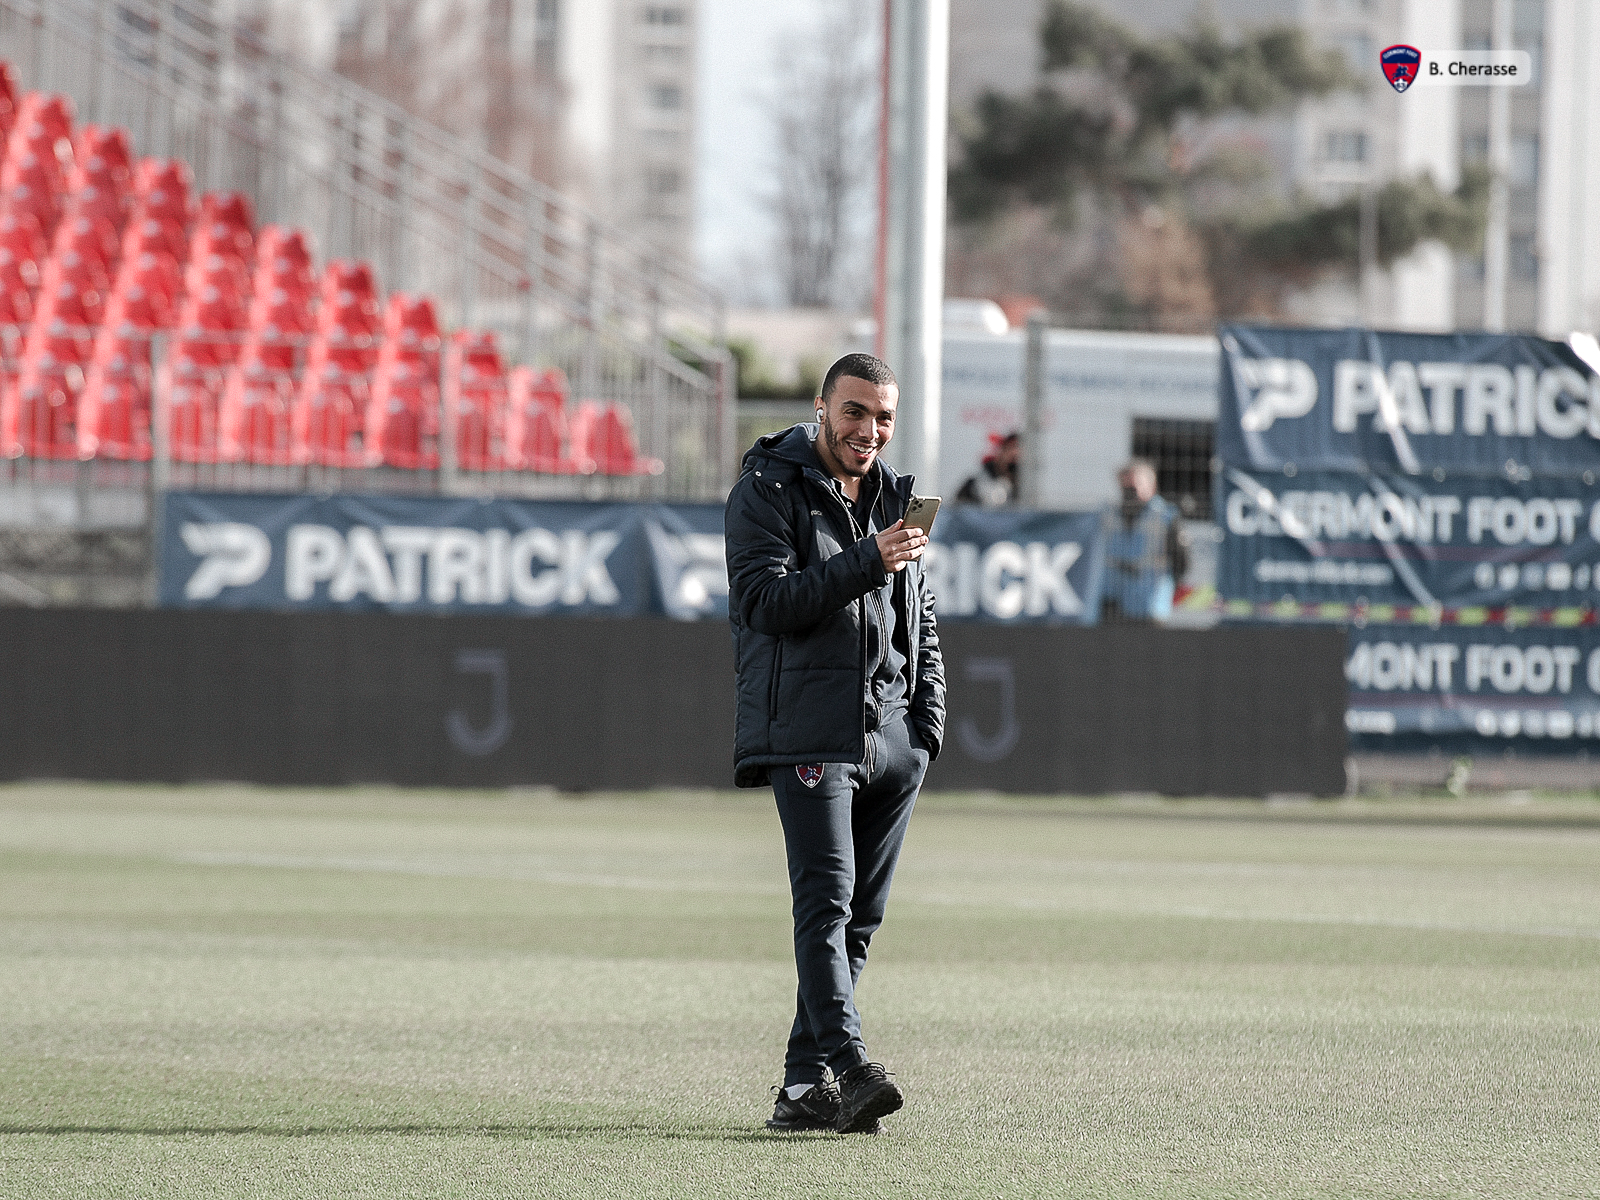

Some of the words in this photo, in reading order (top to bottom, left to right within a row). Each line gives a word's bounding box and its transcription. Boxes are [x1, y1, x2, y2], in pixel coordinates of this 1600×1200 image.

[1467, 496, 1583, 545] FOOT
[284, 523, 620, 607] PATRICK
[1465, 644, 1581, 693] FOOT
